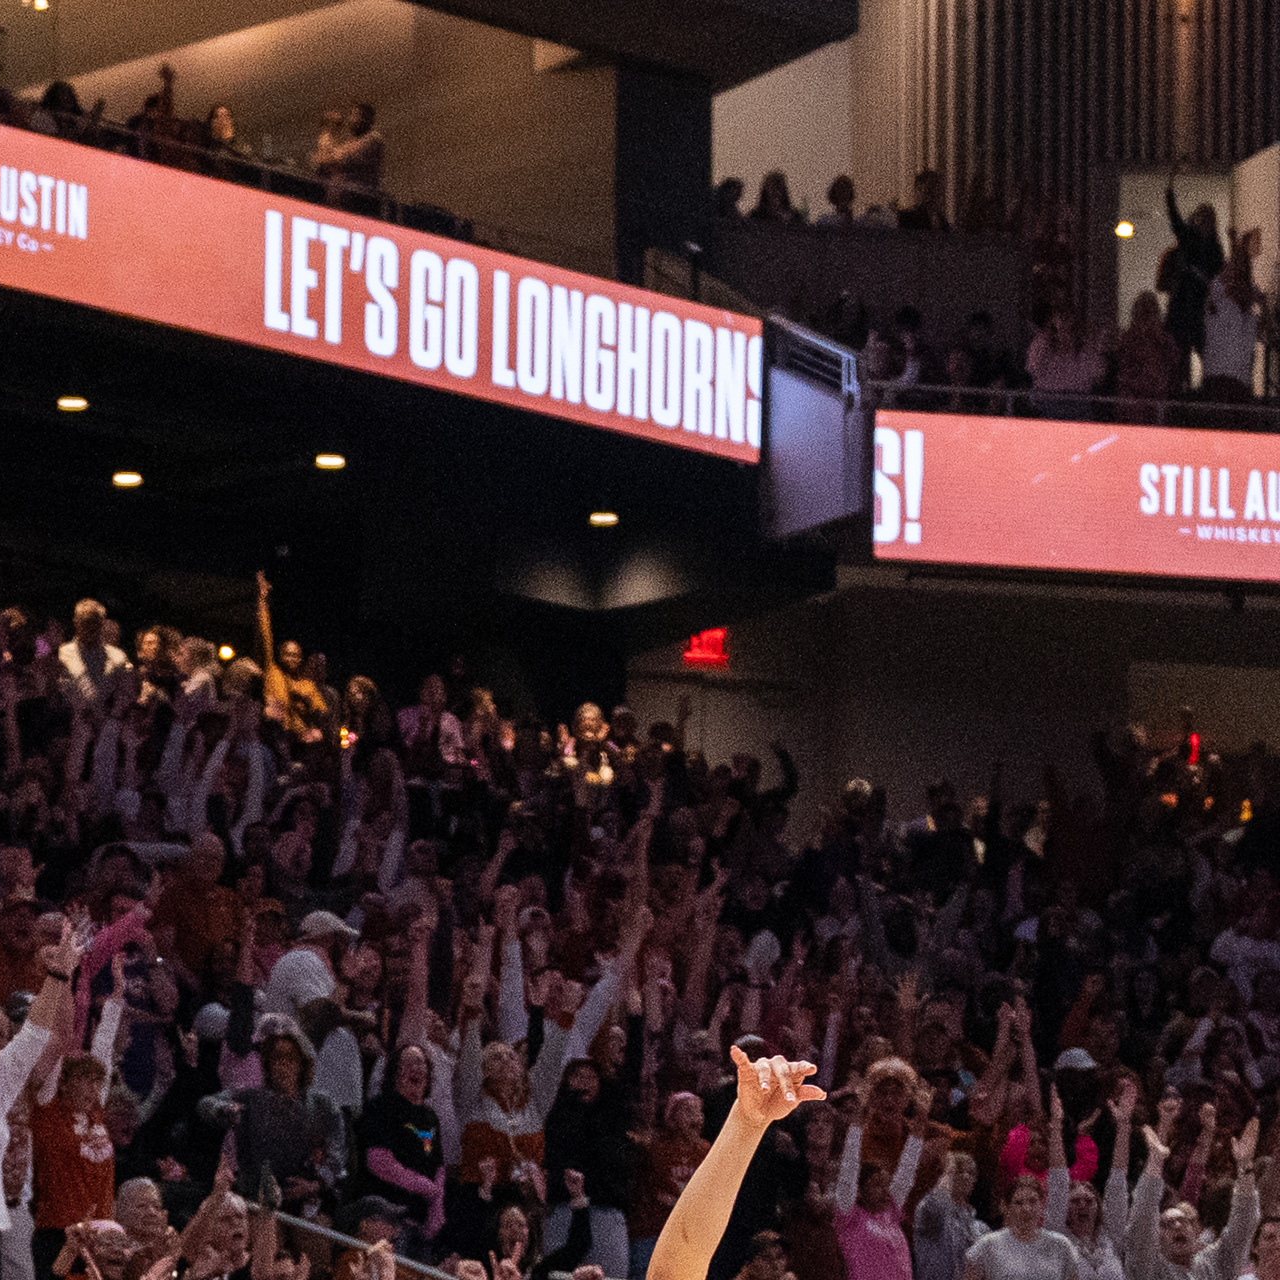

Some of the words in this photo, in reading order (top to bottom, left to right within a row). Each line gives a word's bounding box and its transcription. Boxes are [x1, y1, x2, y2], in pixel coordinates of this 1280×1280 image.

[264, 209, 400, 358] LET'S
[409, 248, 479, 379] GO
[1140, 462, 1236, 520] STILL
